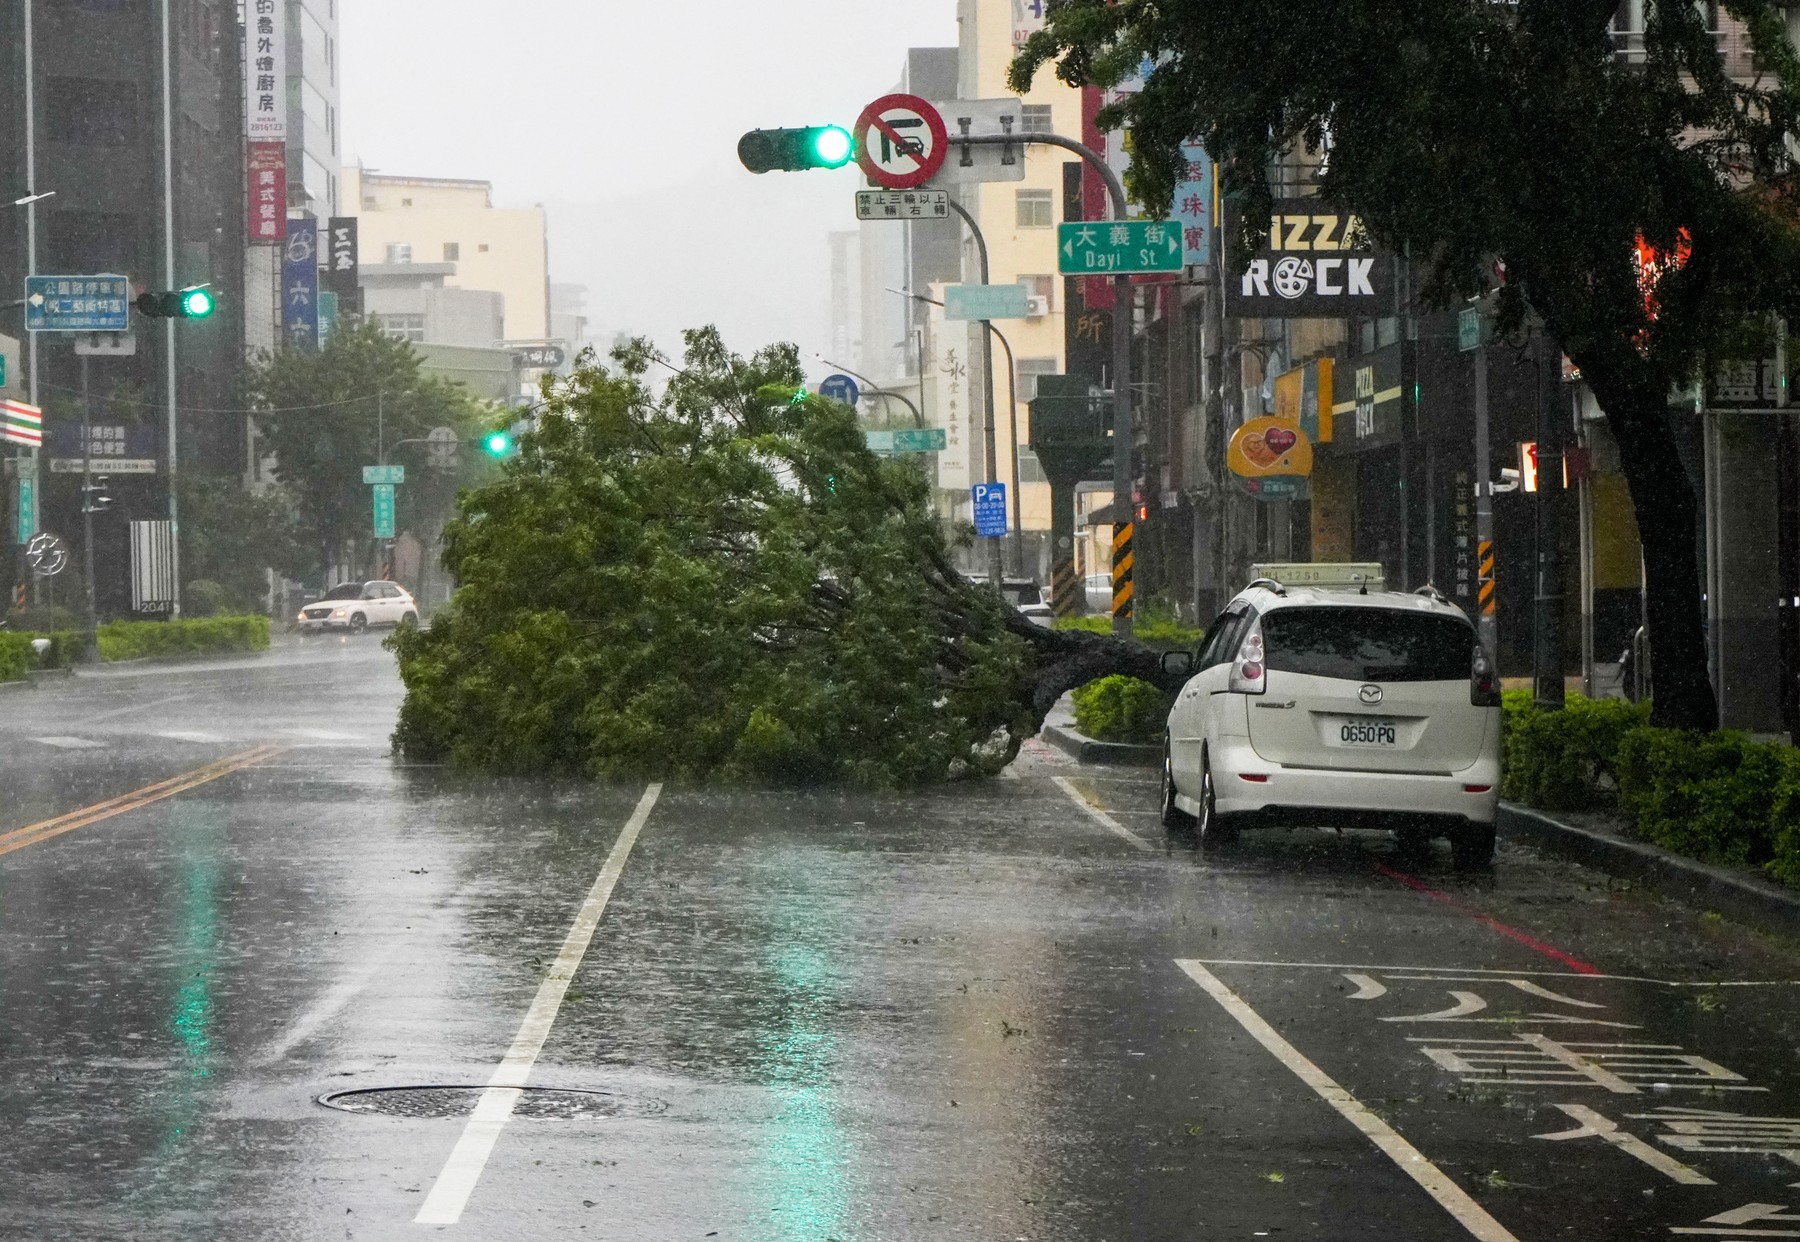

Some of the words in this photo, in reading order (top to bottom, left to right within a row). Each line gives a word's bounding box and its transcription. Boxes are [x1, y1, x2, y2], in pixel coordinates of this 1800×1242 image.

[259, 171, 276, 235] 美式餐廳
[859, 193, 946, 205] 禁止三輪以上
[859, 204, 946, 216] 車輛右轉
[1075, 224, 1166, 247] 大義街
[1242, 214, 1373, 251] IZZA
[1085, 249, 1121, 270] Dayi
[976, 486, 987, 502] P
